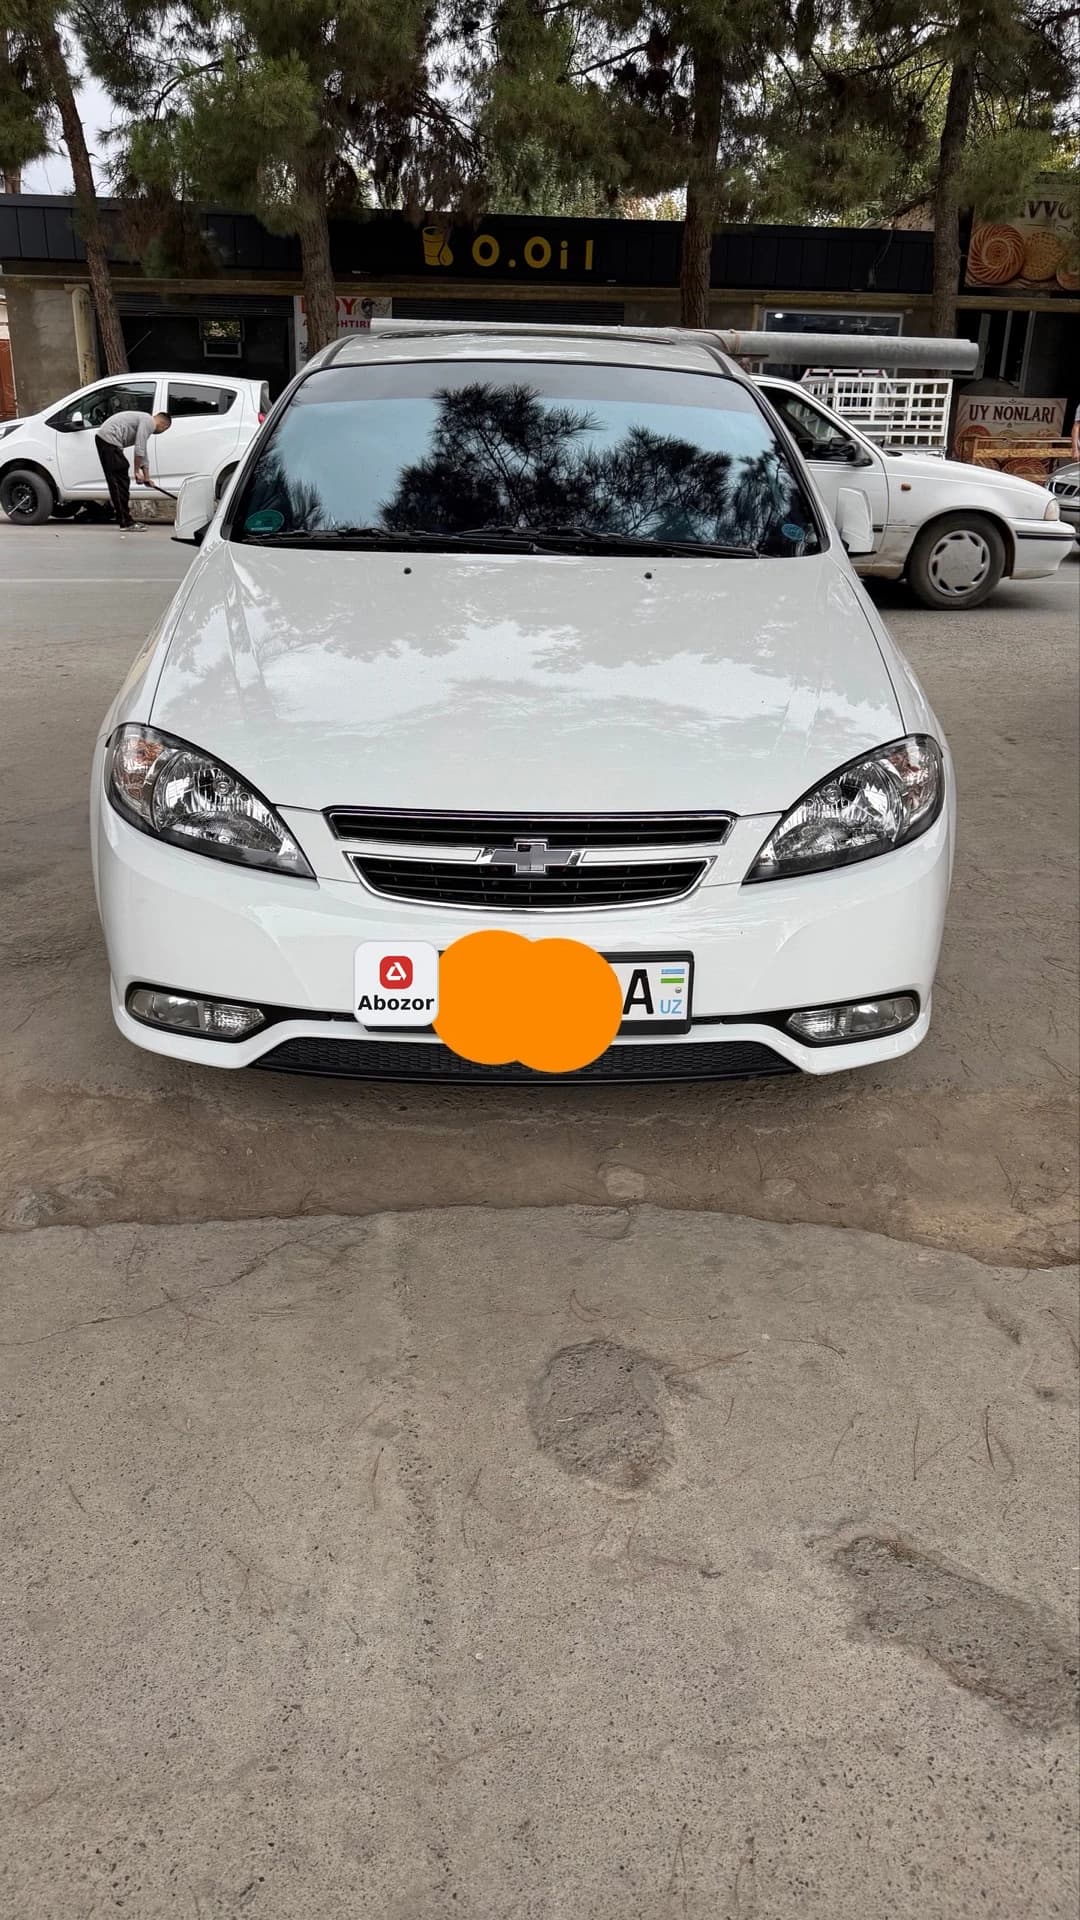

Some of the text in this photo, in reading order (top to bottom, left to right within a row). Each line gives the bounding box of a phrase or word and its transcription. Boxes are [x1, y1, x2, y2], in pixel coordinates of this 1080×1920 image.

[472, 234, 594, 269] O.Oil
[969, 405, 1057, 424] UY NONLARI
[660, 999, 683, 1015] UZ
